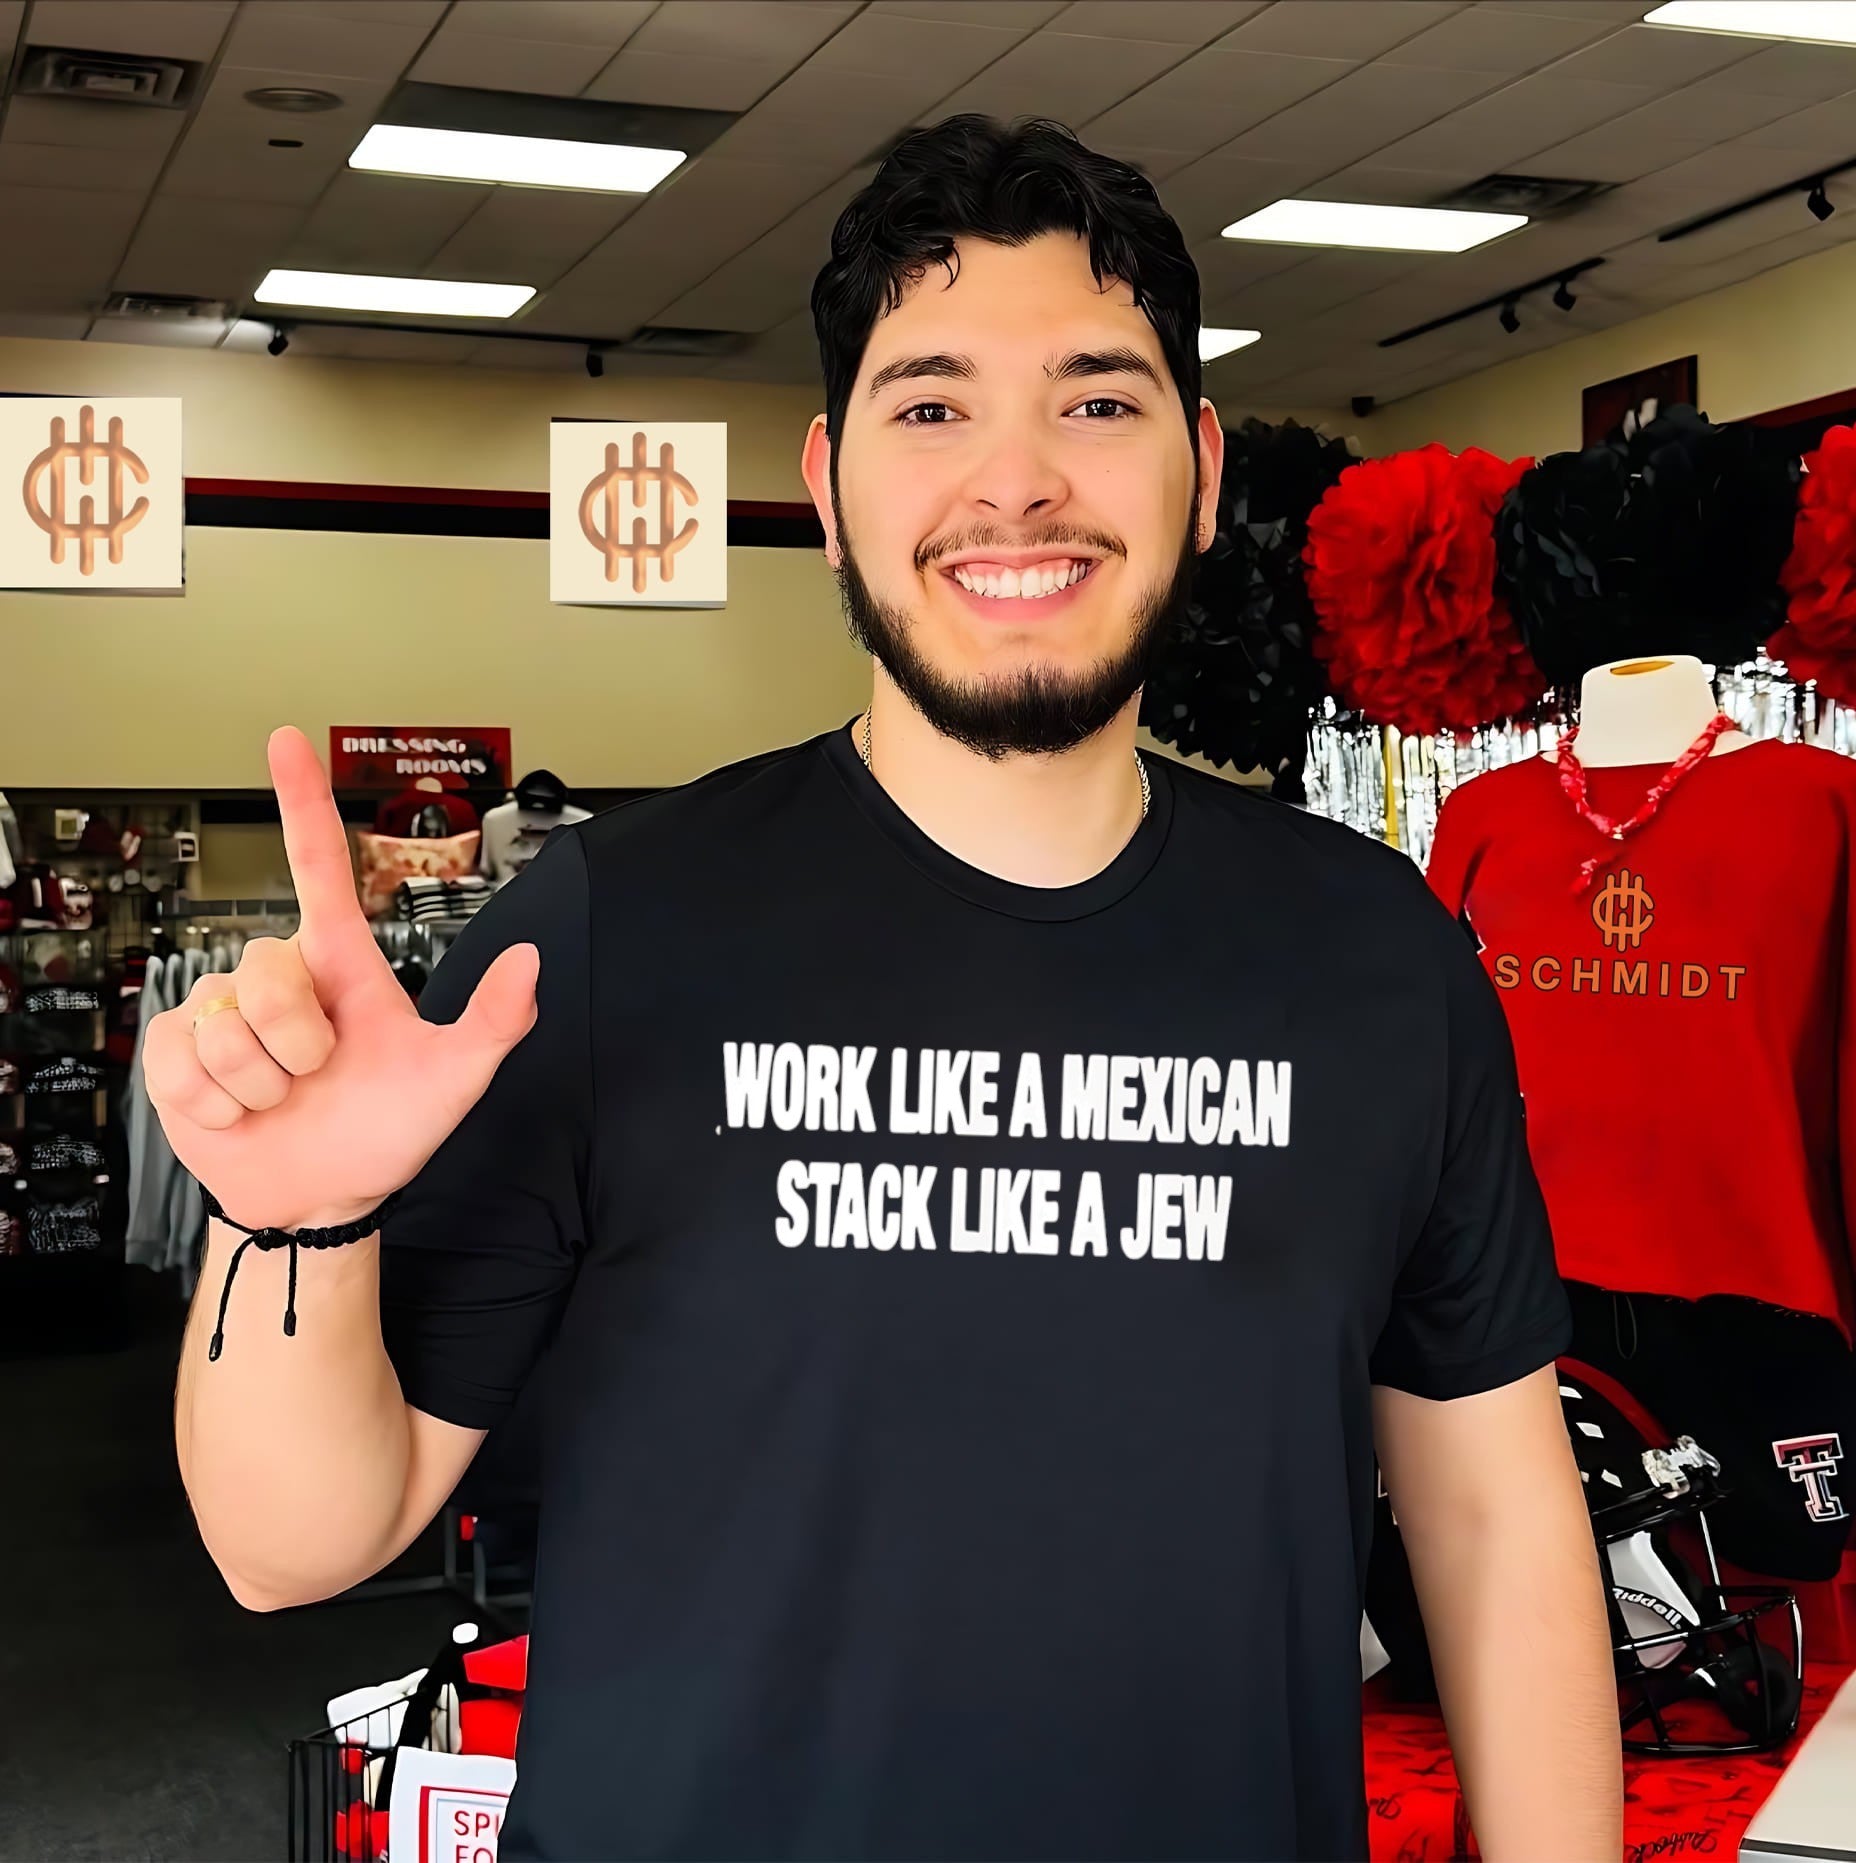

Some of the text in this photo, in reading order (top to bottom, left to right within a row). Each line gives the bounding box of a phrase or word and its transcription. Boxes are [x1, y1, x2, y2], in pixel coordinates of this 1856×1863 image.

[341, 736, 467, 754] DRESSING
[396, 757, 487, 776] ROOMS
[1493, 953, 1747, 1001] SCHMIDT
[722, 1041, 1292, 1148] WORK LIKE A MEXICAN
[774, 1159, 1233, 1262] STACK LIKE A JEW
